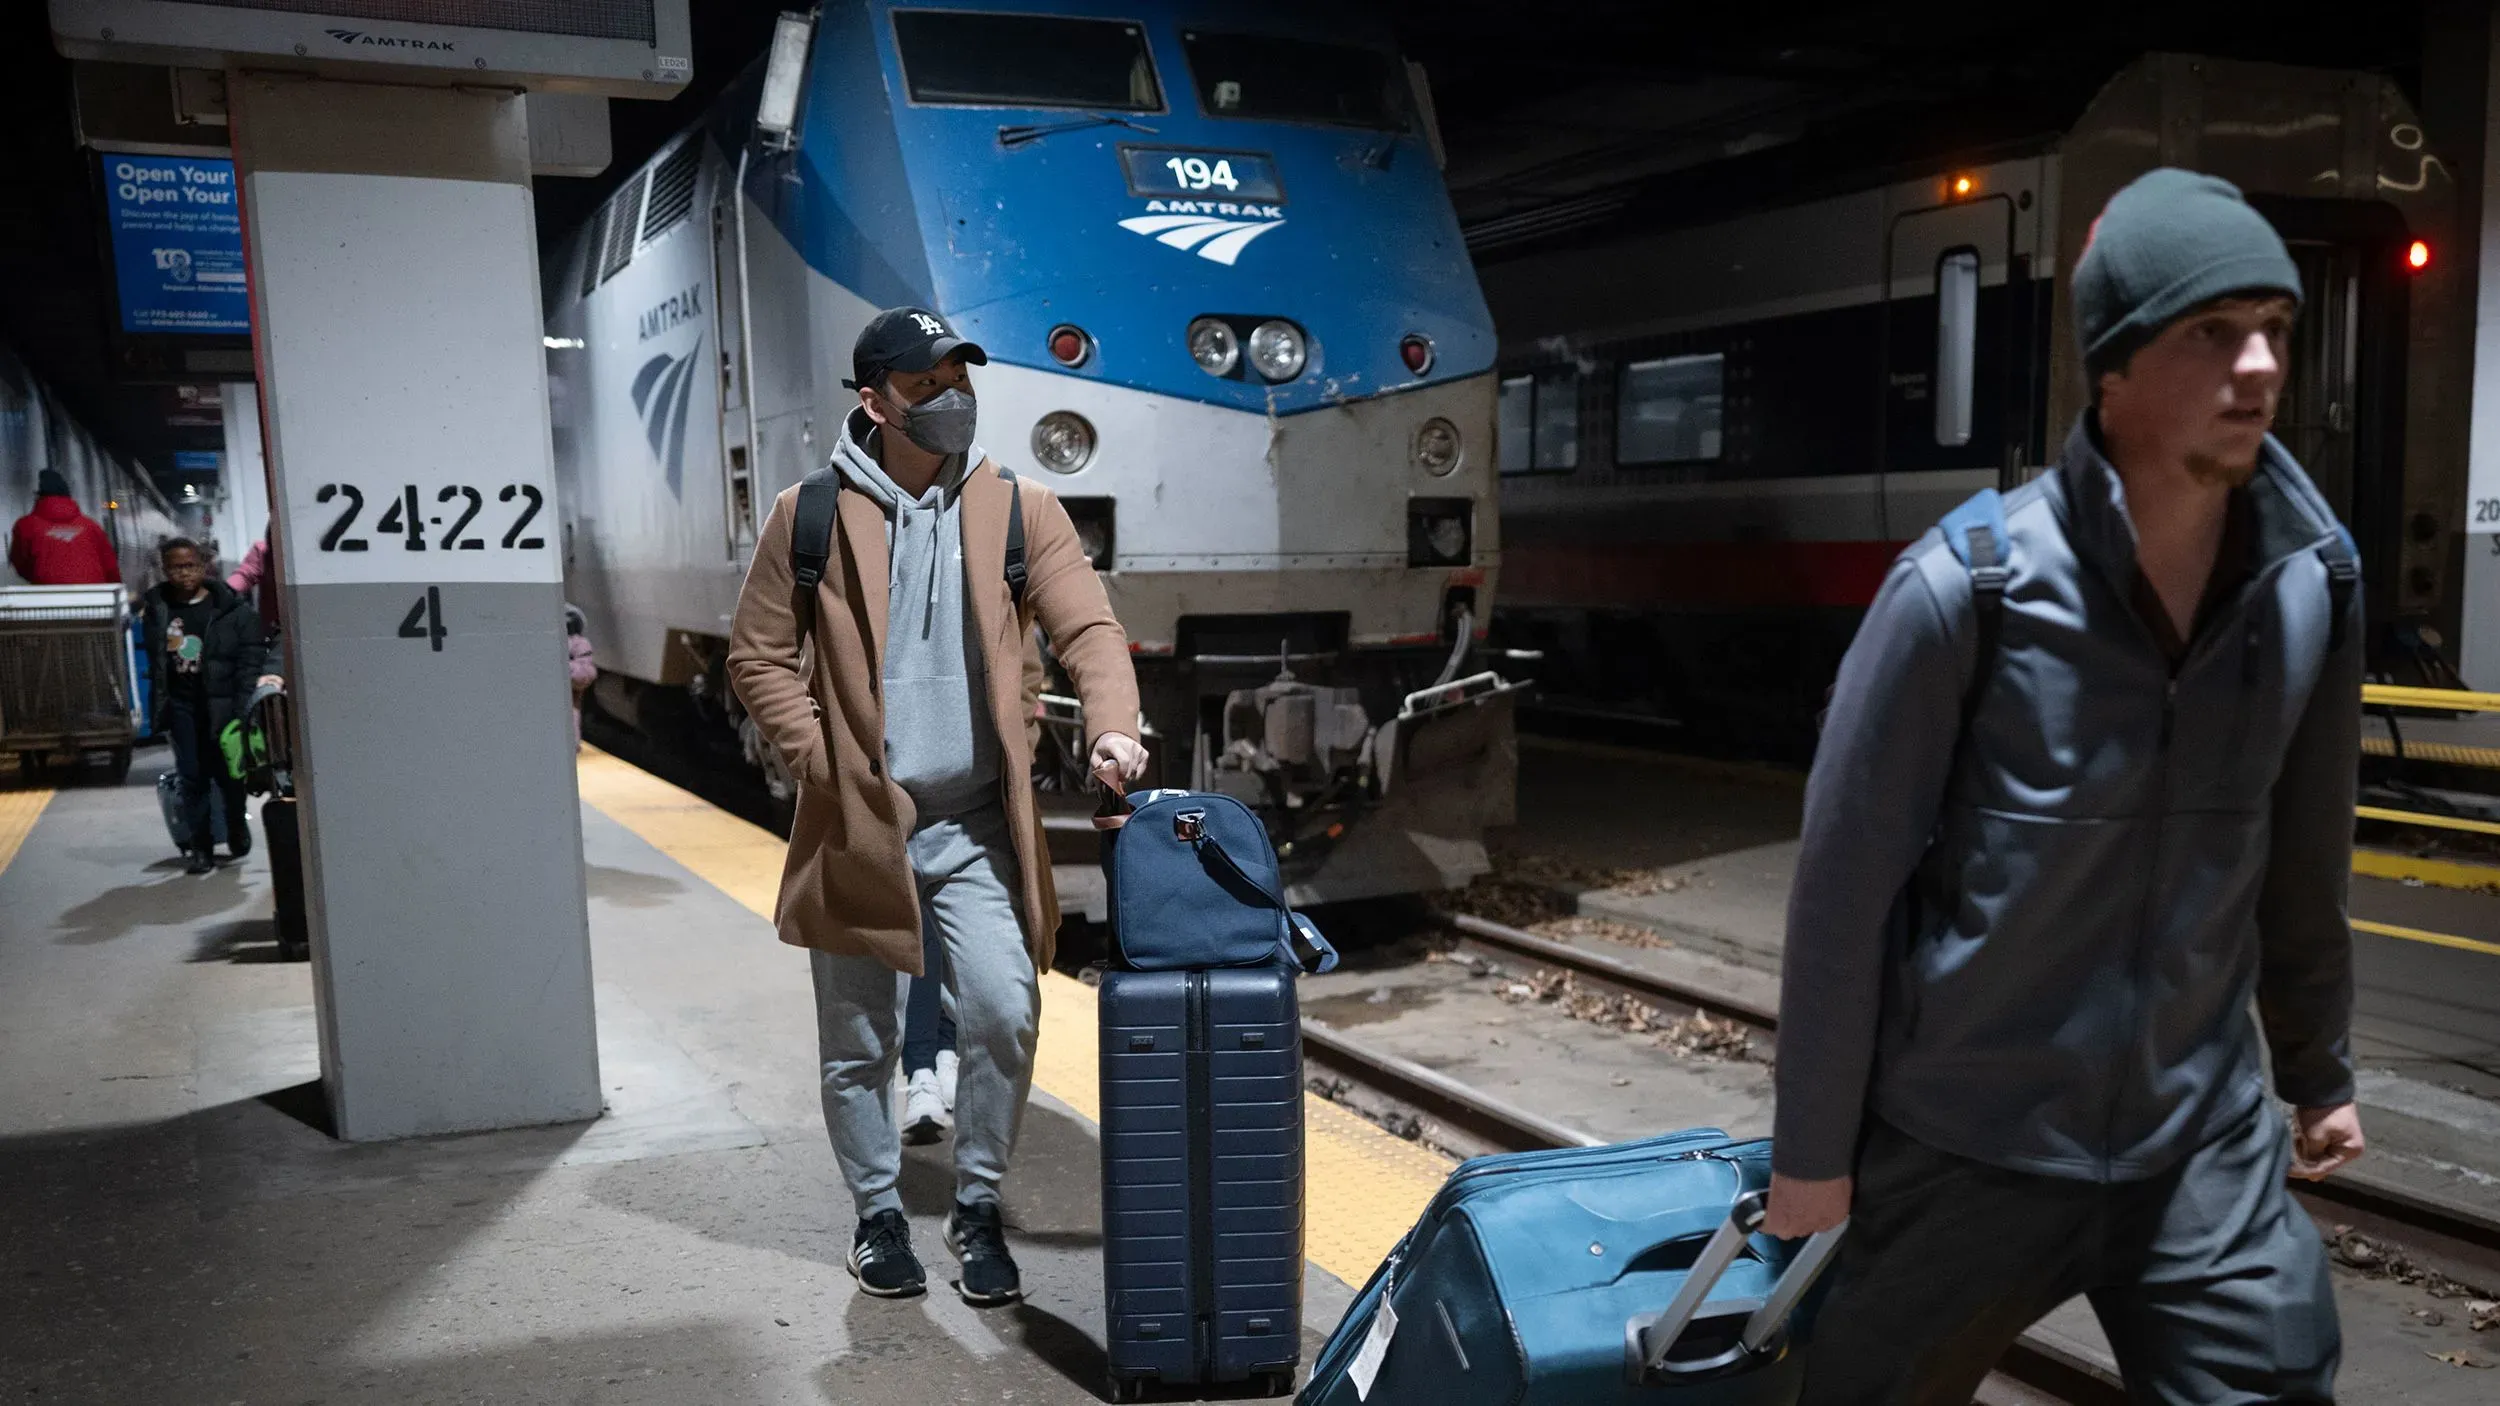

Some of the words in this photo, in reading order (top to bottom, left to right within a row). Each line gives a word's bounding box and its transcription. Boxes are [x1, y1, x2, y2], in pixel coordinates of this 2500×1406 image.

[361, 36, 455, 51] AMTRAK
[116, 162, 177, 185] Open
[179, 165, 229, 184] Your
[1165, 157, 1239, 192] 194
[119, 182, 179, 205] Open
[182, 185, 231, 204] Your
[1145, 200, 1283, 219] AMTRAK
[638, 282, 703, 345] AMTRAK
[910, 313, 944, 335] LA
[316, 483, 545, 551] 24-22
[398, 585, 448, 652] 4
